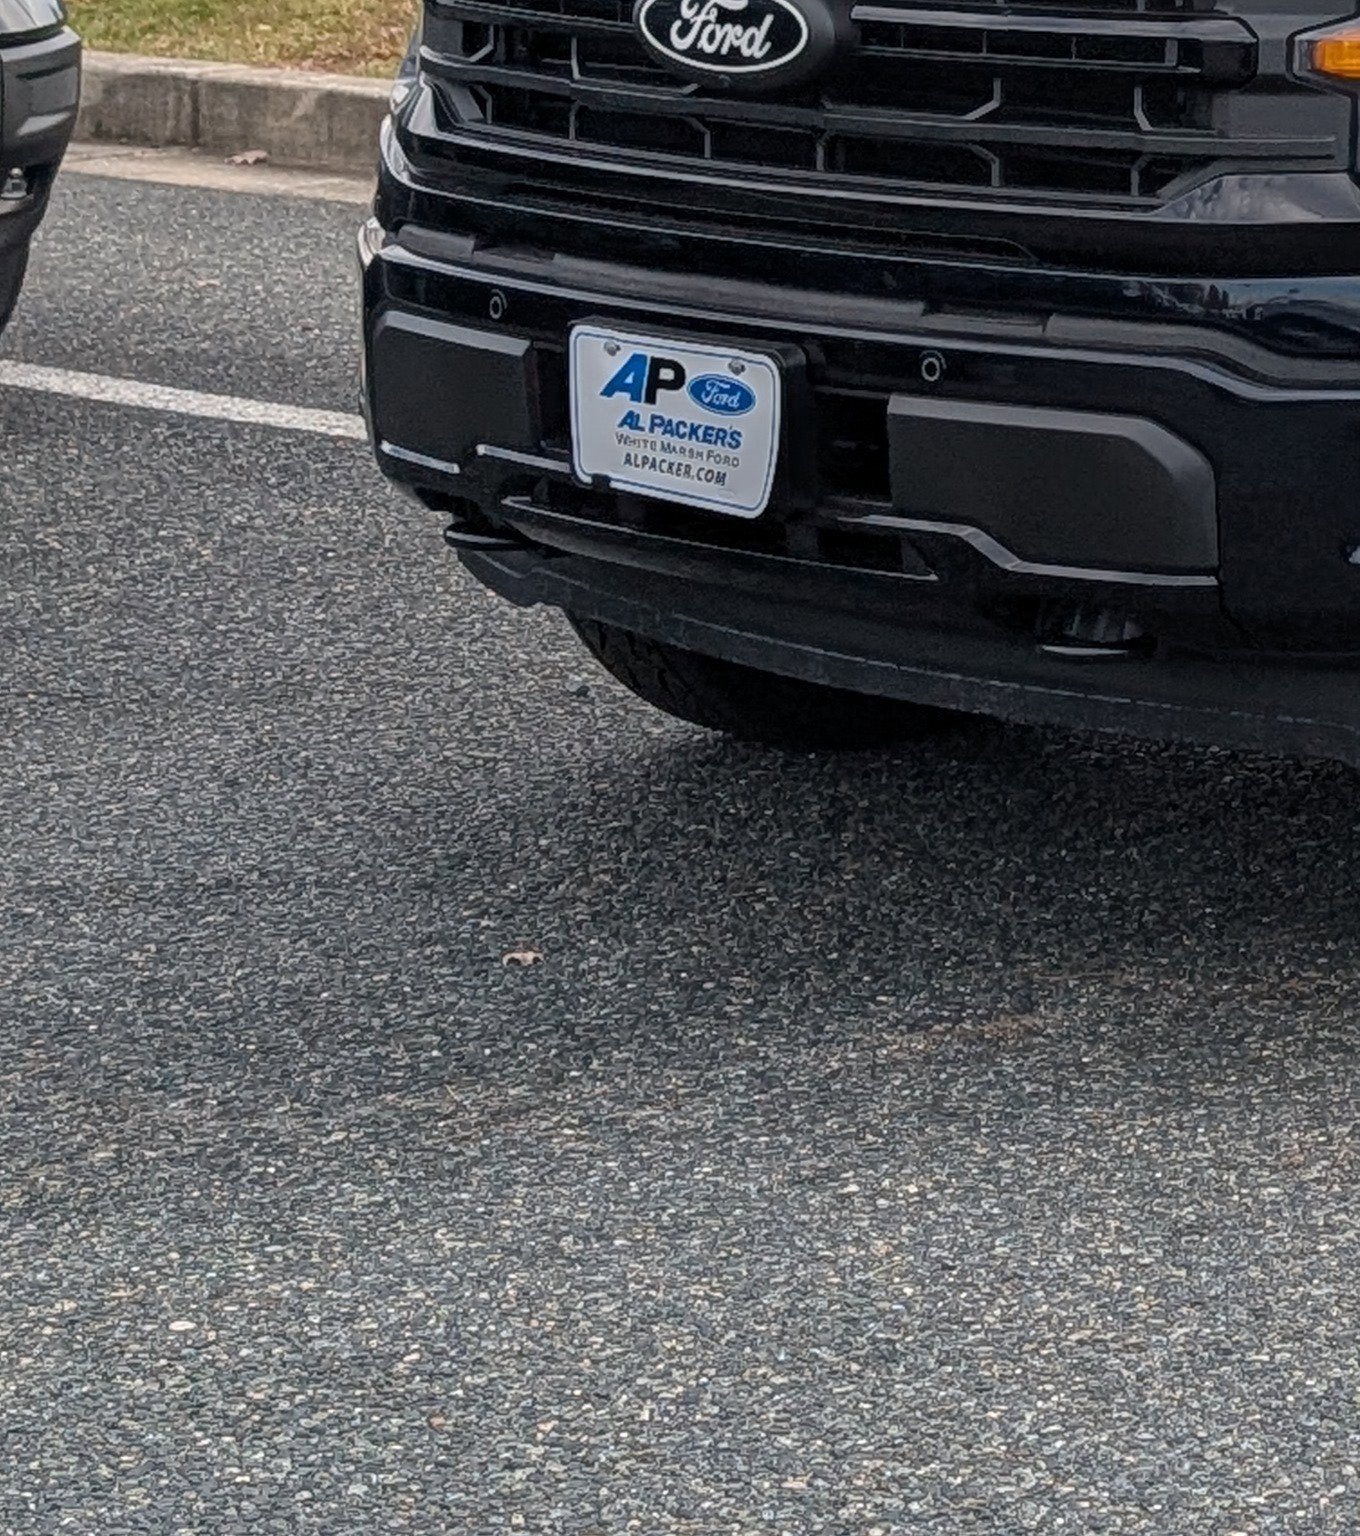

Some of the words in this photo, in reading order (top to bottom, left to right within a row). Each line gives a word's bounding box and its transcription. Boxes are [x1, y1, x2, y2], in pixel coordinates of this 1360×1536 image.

[600, 353, 686, 405] AP
[701, 379, 741, 409] Ford
[618, 410, 646, 432] AL
[623, 453, 727, 486] ALPACKER.COM
[706, 449, 740, 469] FORD
